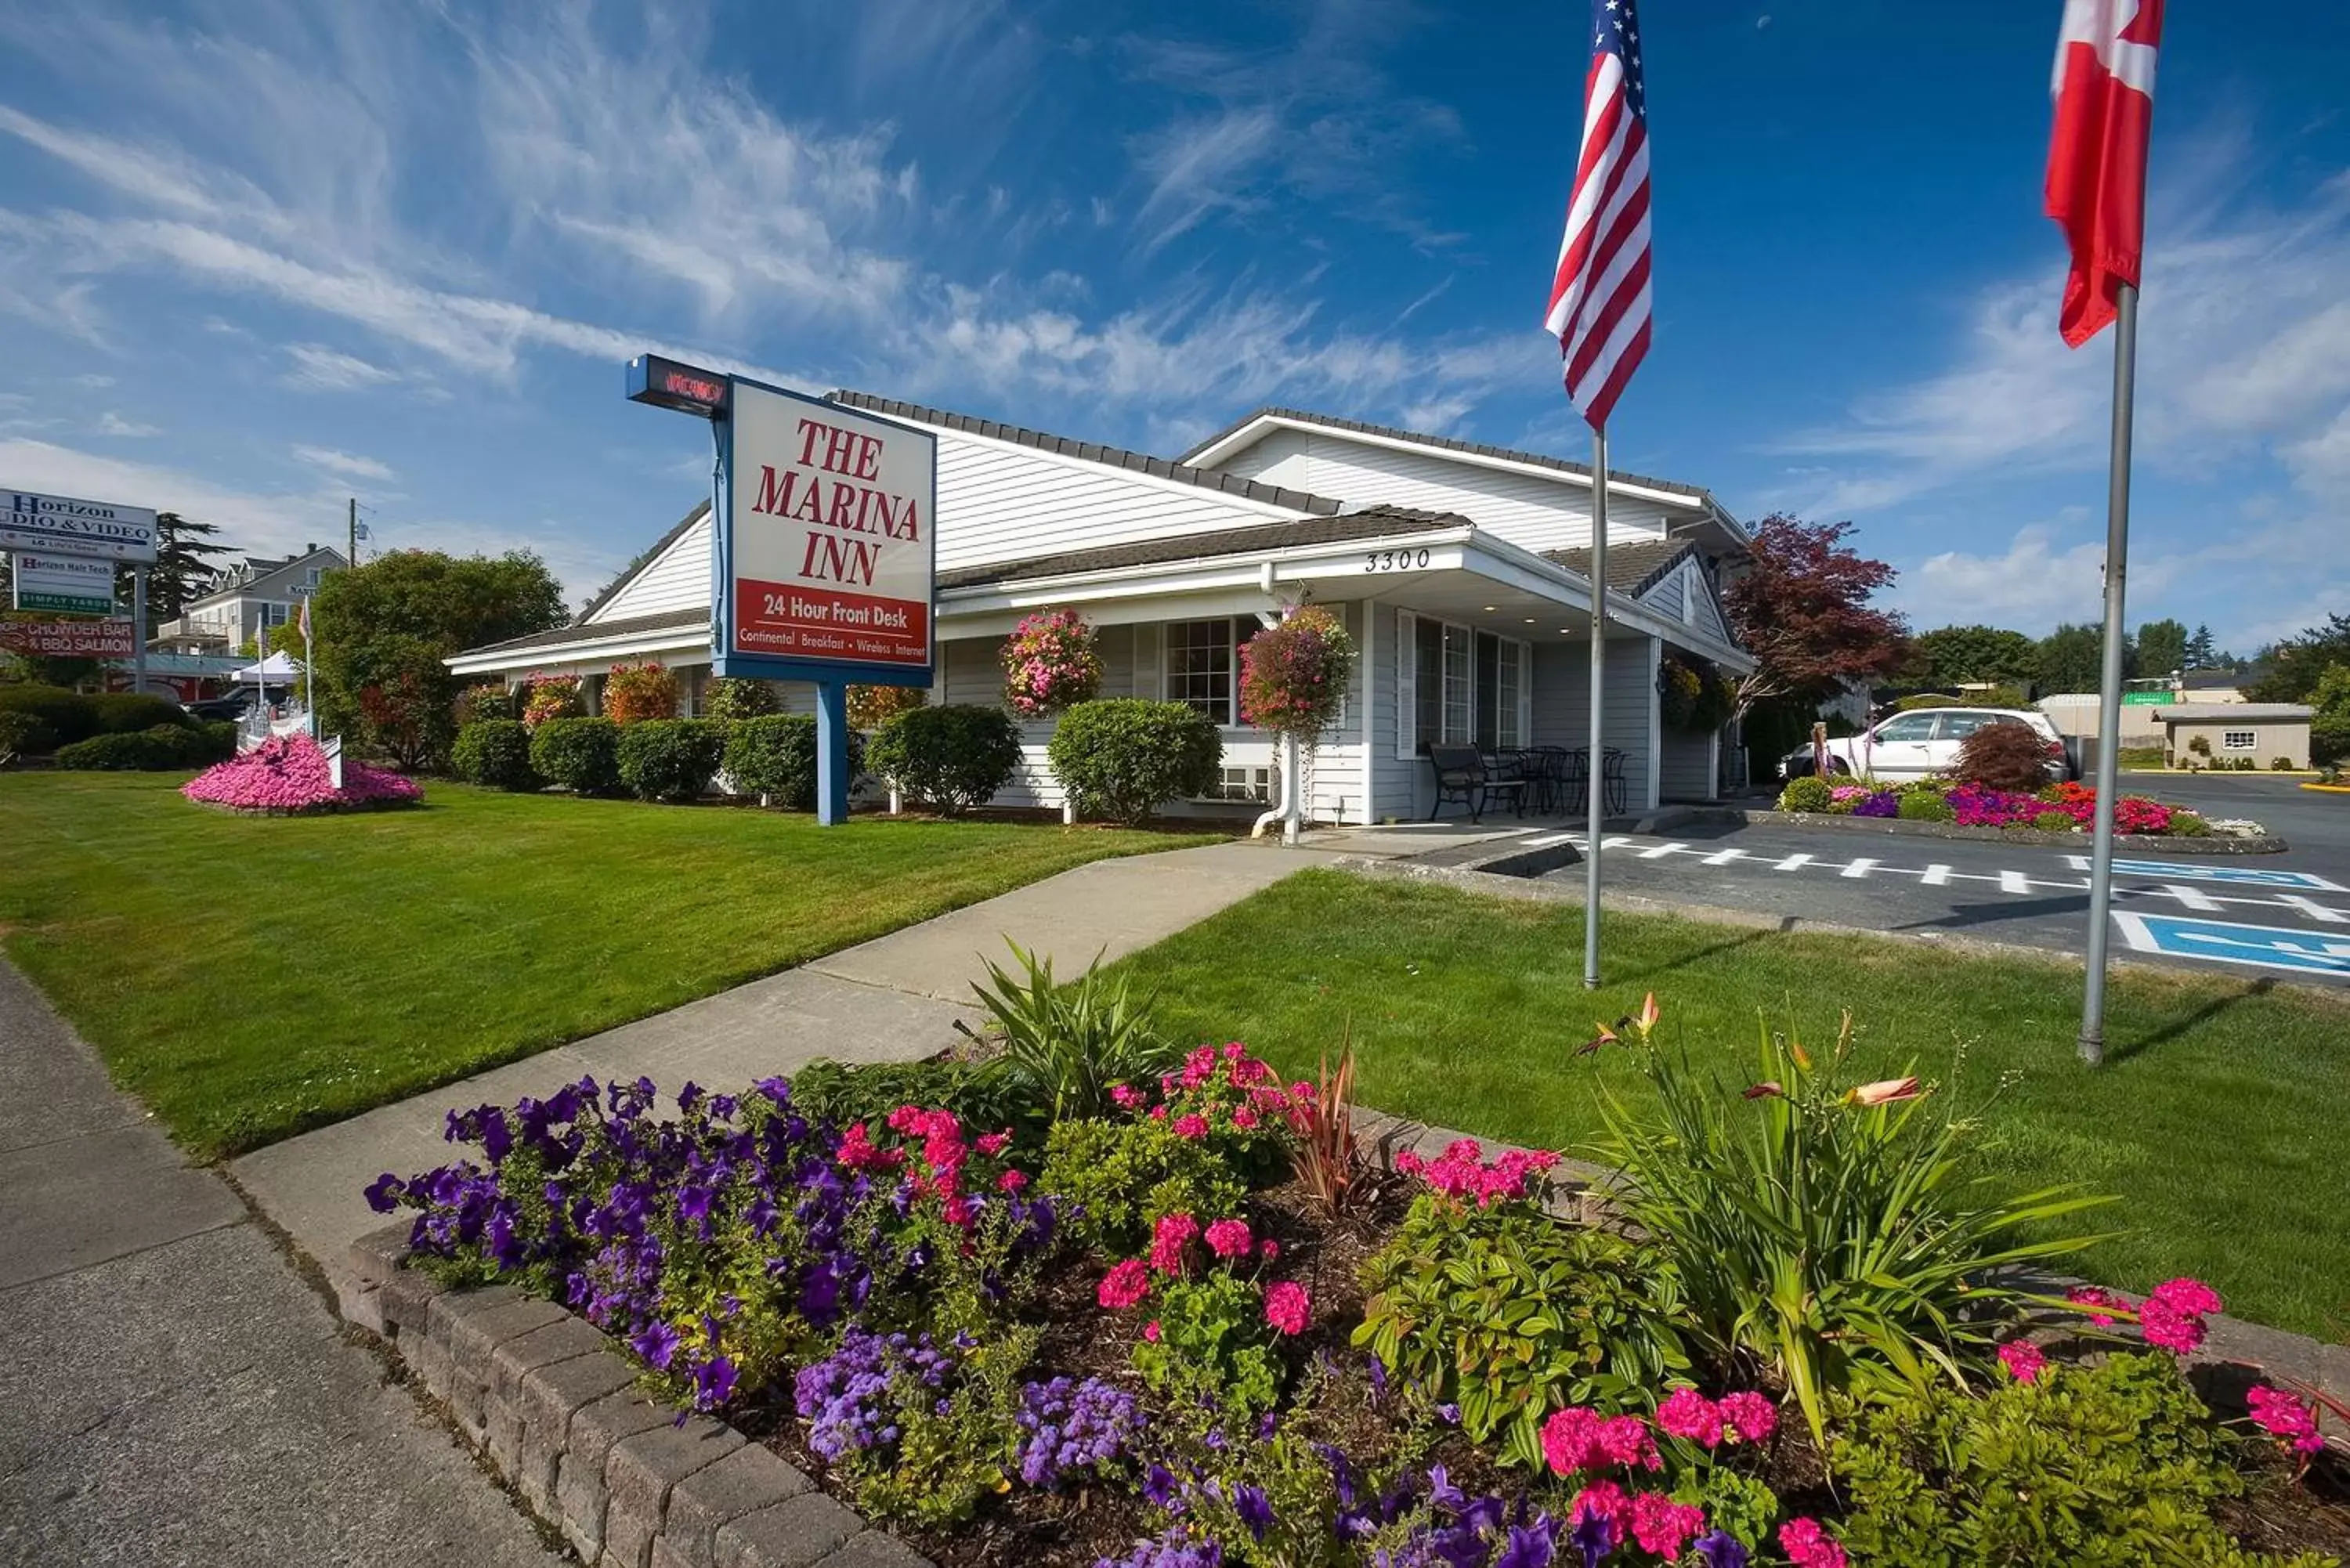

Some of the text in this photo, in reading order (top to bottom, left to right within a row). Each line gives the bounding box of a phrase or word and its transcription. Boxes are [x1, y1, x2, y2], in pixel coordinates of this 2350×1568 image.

[797, 417, 884, 482] THE
[13, 494, 115, 518] Horizon
[751, 464, 919, 542] MARINA
[61, 519, 78, 530] &
[81, 521, 151, 539] VIDEO
[797, 531, 882, 587] INN
[1365, 549, 1430, 573] 3300
[764, 594, 908, 628] 24 Hour Front Desk
[27, 623, 101, 635] CHOWDER
[103, 624, 131, 636] BAR
[739, 627, 926, 656] Continental Breakfast Wireless Internet
[42, 638, 73, 651] BBQ
[74, 638, 132, 652] SALMON
